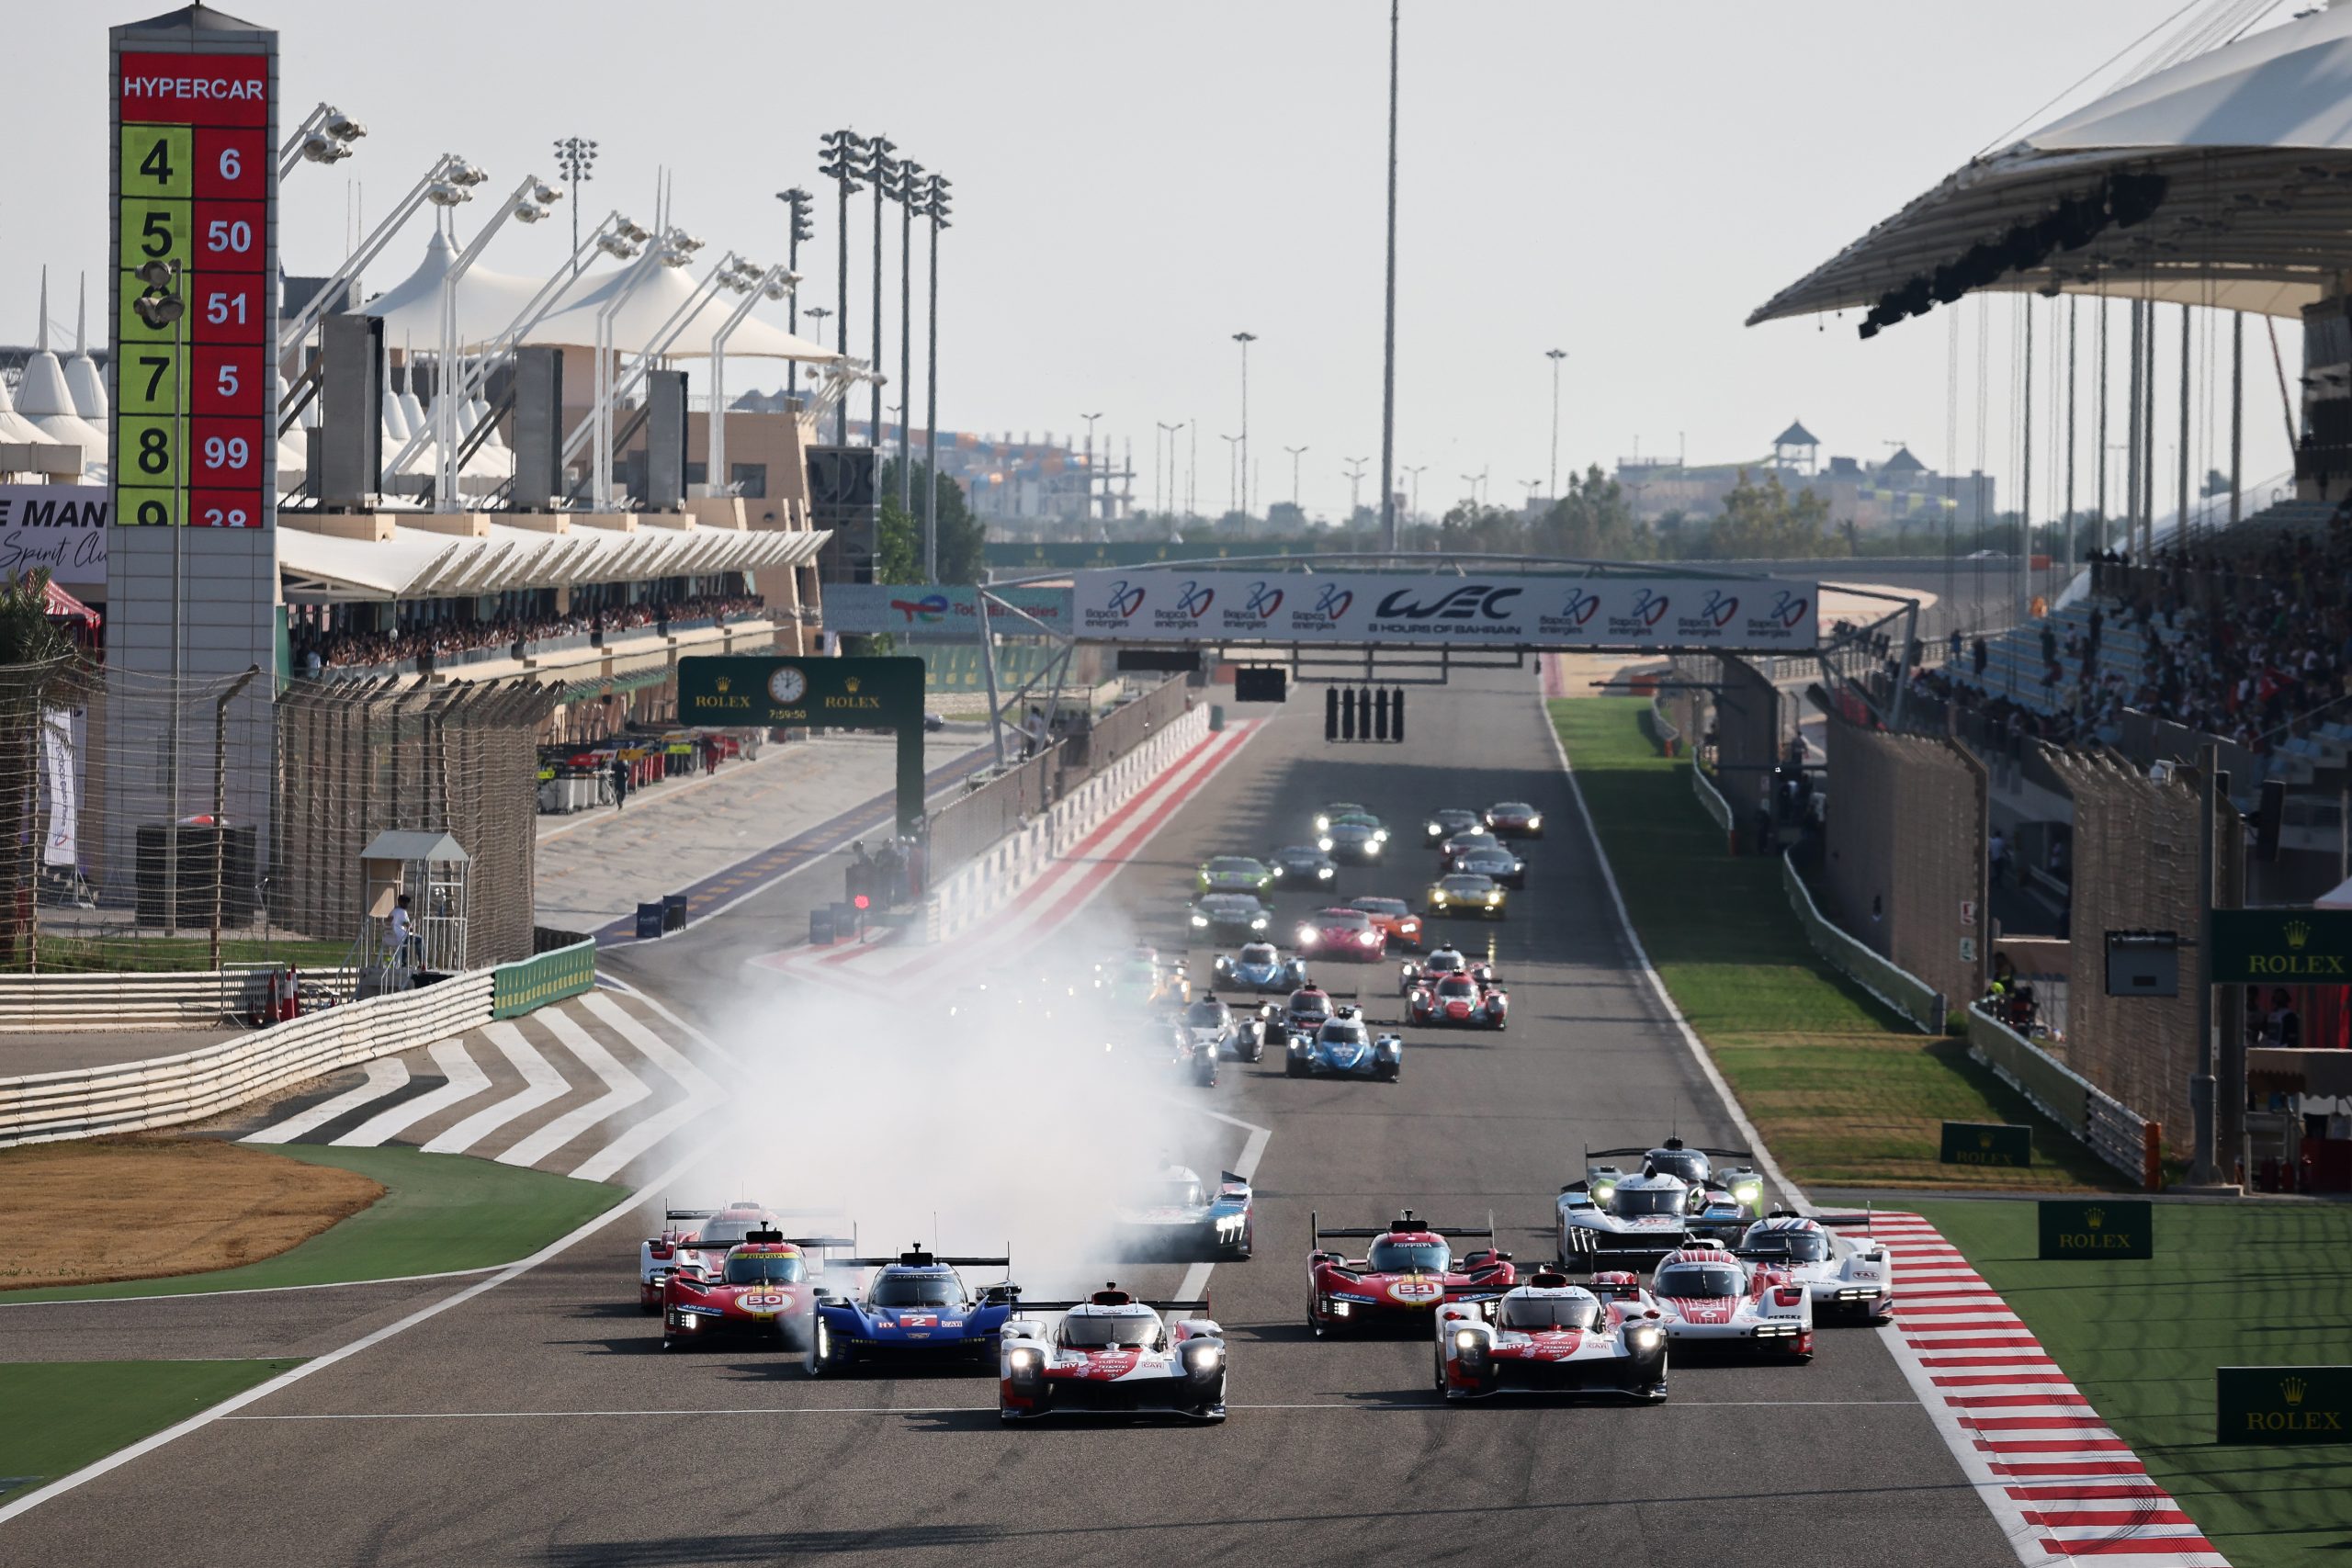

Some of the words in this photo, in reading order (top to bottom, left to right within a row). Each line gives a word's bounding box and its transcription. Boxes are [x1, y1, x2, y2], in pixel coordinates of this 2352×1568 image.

[124, 76, 264, 100] HYPERCAR
[140, 139, 174, 186] 4
[220, 148, 241, 180] 6
[141, 211, 173, 258] 5
[208, 220, 251, 253] 50
[207, 293, 246, 324] 51
[139, 356, 170, 401] 7
[217, 365, 239, 396] 5
[138, 428, 169, 474] 8
[204, 436, 248, 468] 99
[0, 531, 72, 572] Spirit
[1375, 585, 1524, 619] WEC
[1381, 624, 1431, 634] HOURS
[1433, 625, 1453, 634] OF
[1454, 625, 1522, 635] BAHRAIN
[695, 695, 751, 708] ROLEX
[825, 696, 881, 708] ROLEX
[2248, 955, 2345, 974] ROLEX
[1956, 1150, 2013, 1166] ROLEX
[2059, 1234, 2132, 1248] ROLEX
[1400, 1284, 1433, 1293] 51
[683, 1303, 707, 1313] ADLER
[748, 1295, 782, 1304] 50
[910, 1317, 927, 1326] 2
[1700, 1310, 1717, 1318] 6
[2246, 1412, 2342, 1430] ROLEX
